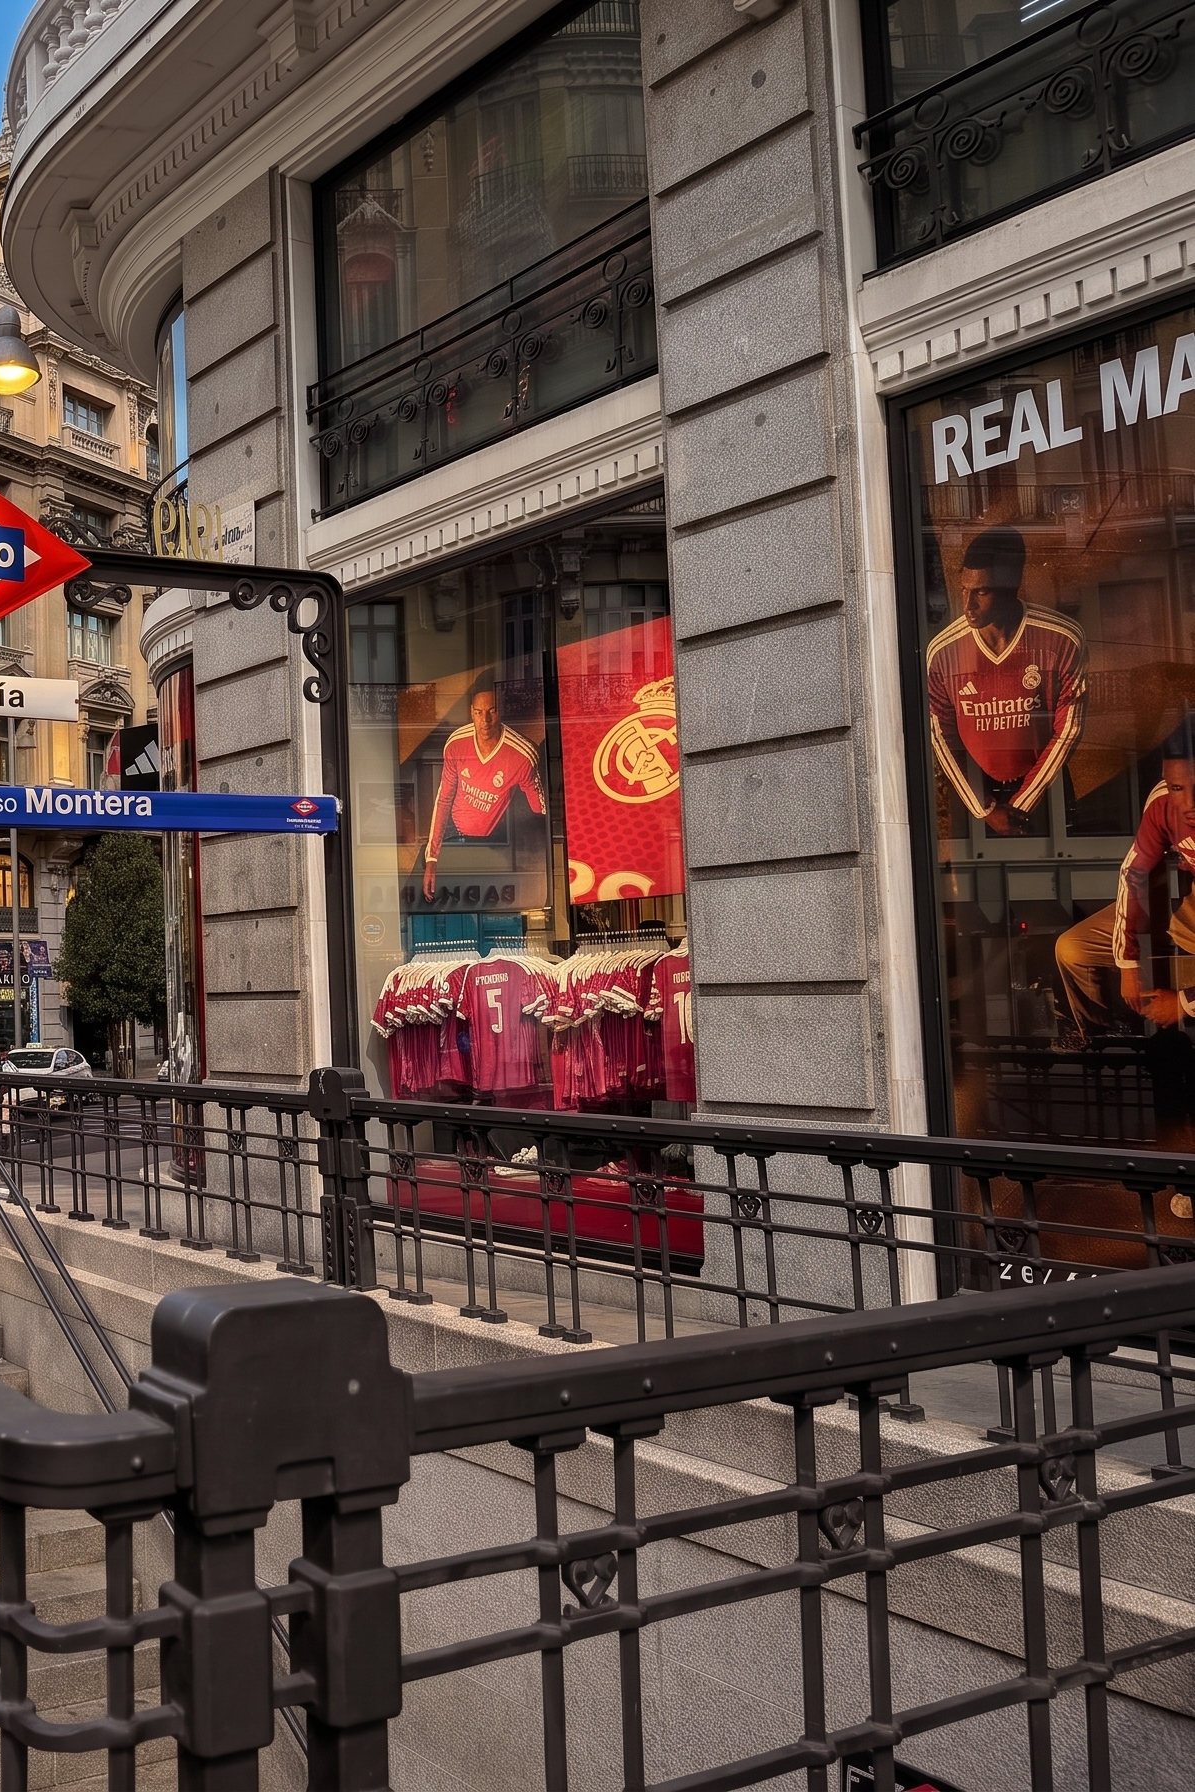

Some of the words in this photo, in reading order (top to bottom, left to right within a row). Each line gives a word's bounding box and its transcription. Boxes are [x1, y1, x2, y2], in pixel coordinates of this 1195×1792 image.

[932, 379, 1083, 484] REAL
[1099, 332, 1195, 432] MA
[960, 694, 1041, 717] Emirates
[976, 718, 992, 732] FLY
[993, 713, 1031, 731] BETTER
[26, 788, 153, 816] Montera
[486, 988, 503, 1034] 5
